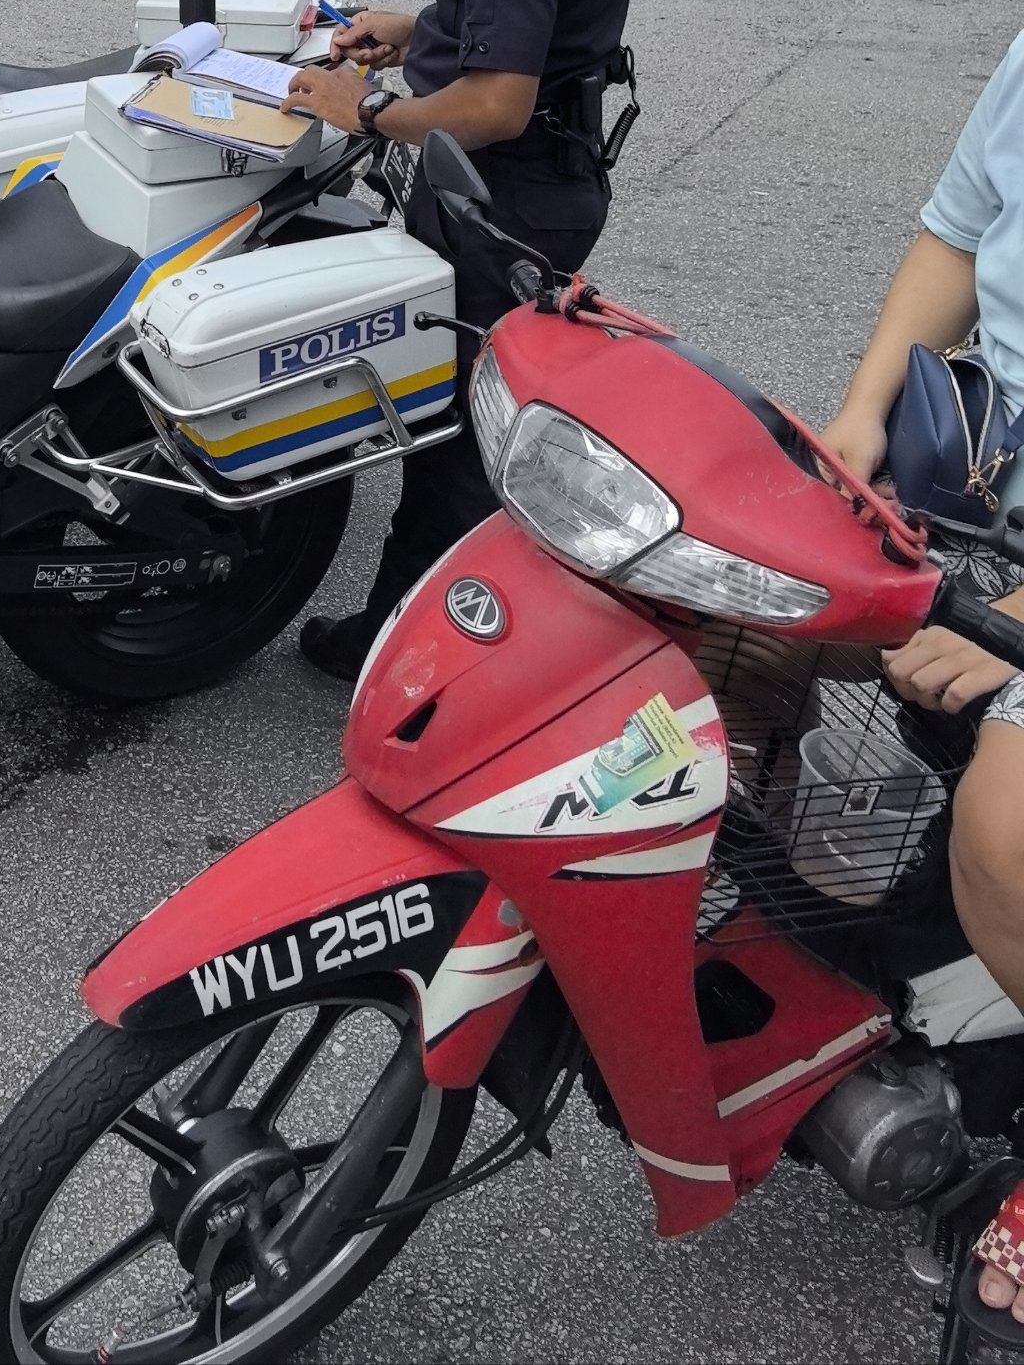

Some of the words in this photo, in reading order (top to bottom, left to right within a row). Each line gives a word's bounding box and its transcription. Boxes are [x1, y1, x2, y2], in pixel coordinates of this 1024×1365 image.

[270, 311, 396, 376] POLIS
[188, 934, 304, 1017] WYU
[309, 882, 435, 973] 2516
